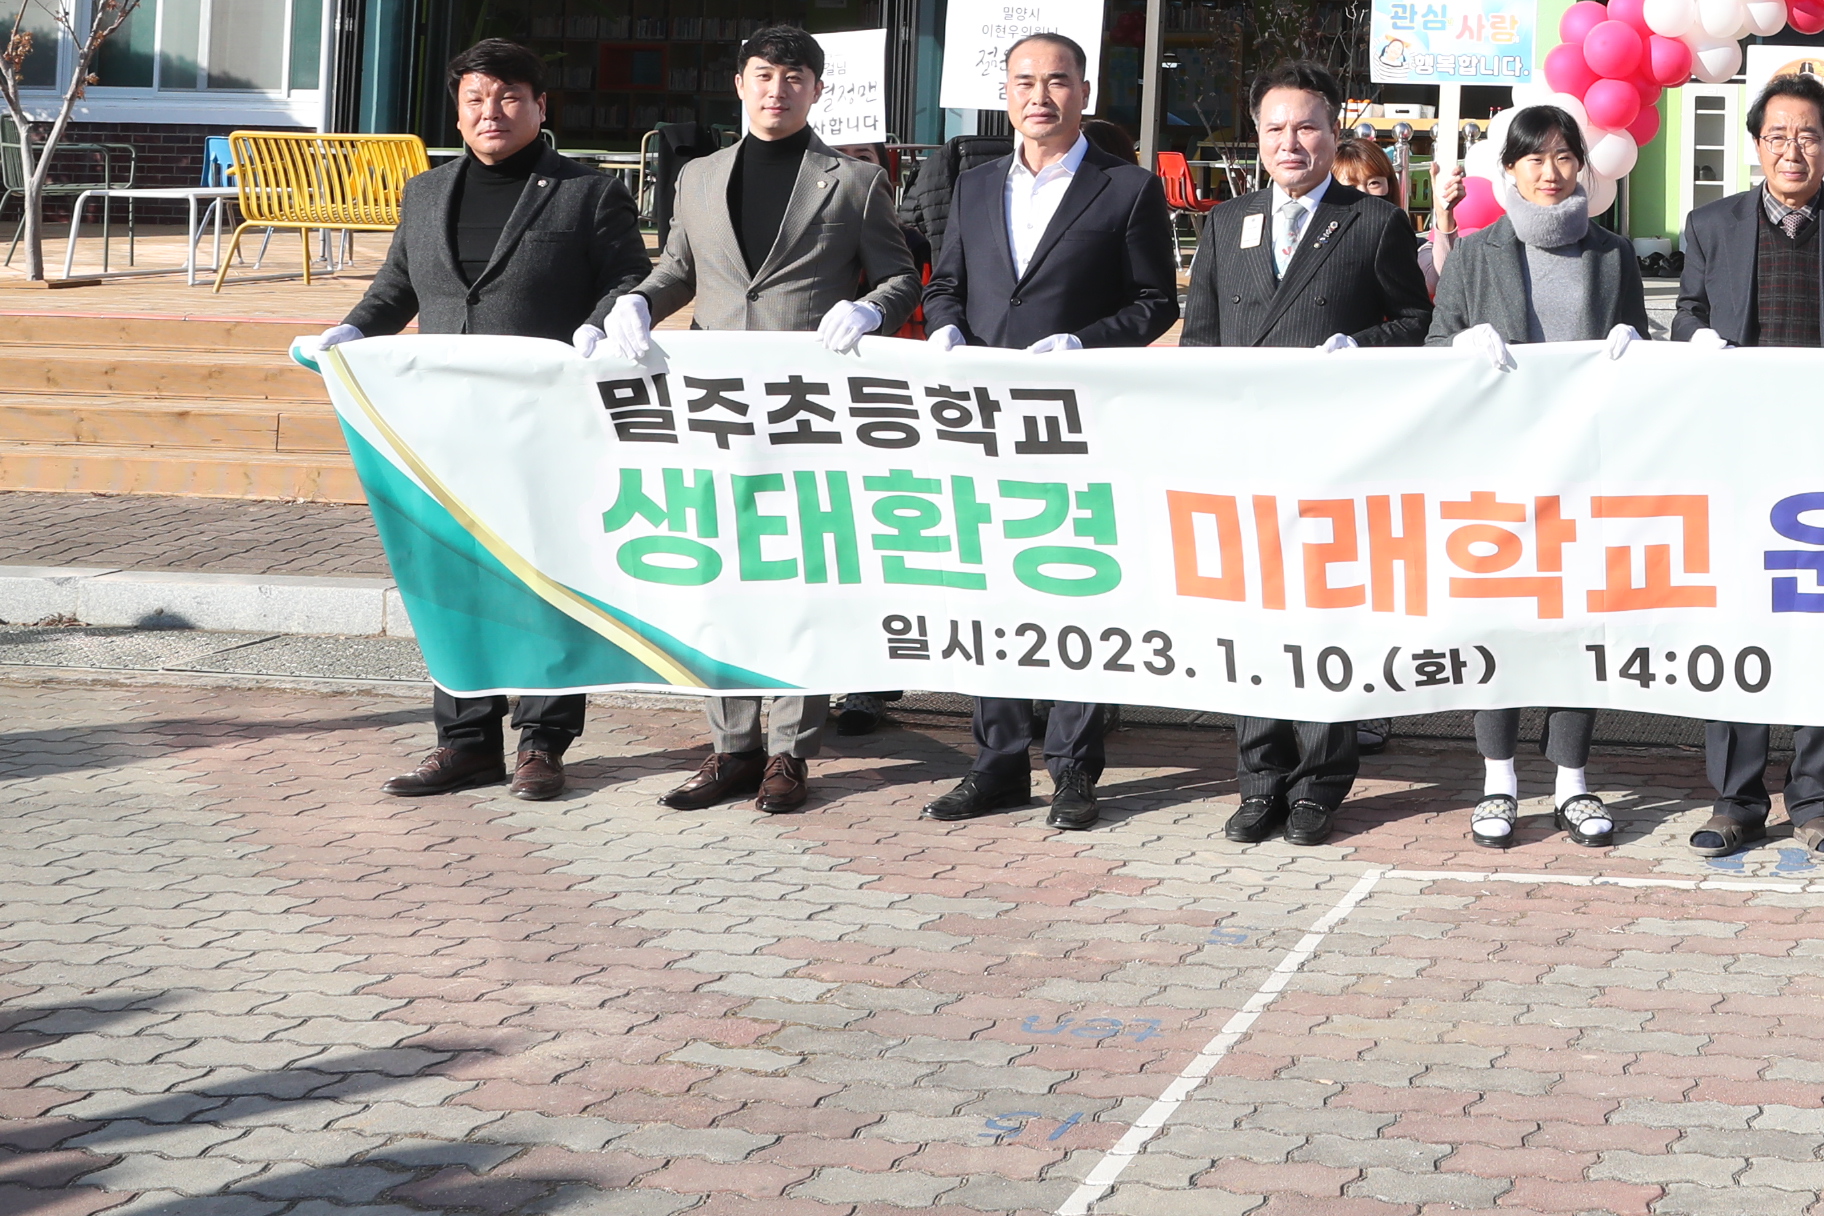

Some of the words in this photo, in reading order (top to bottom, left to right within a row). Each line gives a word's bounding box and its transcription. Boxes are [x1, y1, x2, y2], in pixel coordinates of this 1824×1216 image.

[1003, 6, 1040, 22] 밀양시
[1413, 53, 1530, 77] 행복합니다.
[595, 372, 1089, 458] 밀주초등학교
[601, 467, 1123, 597] 생태환경
[1165, 490, 1717, 620] 미래학교
[1586, 644, 1771, 695] 14:00
